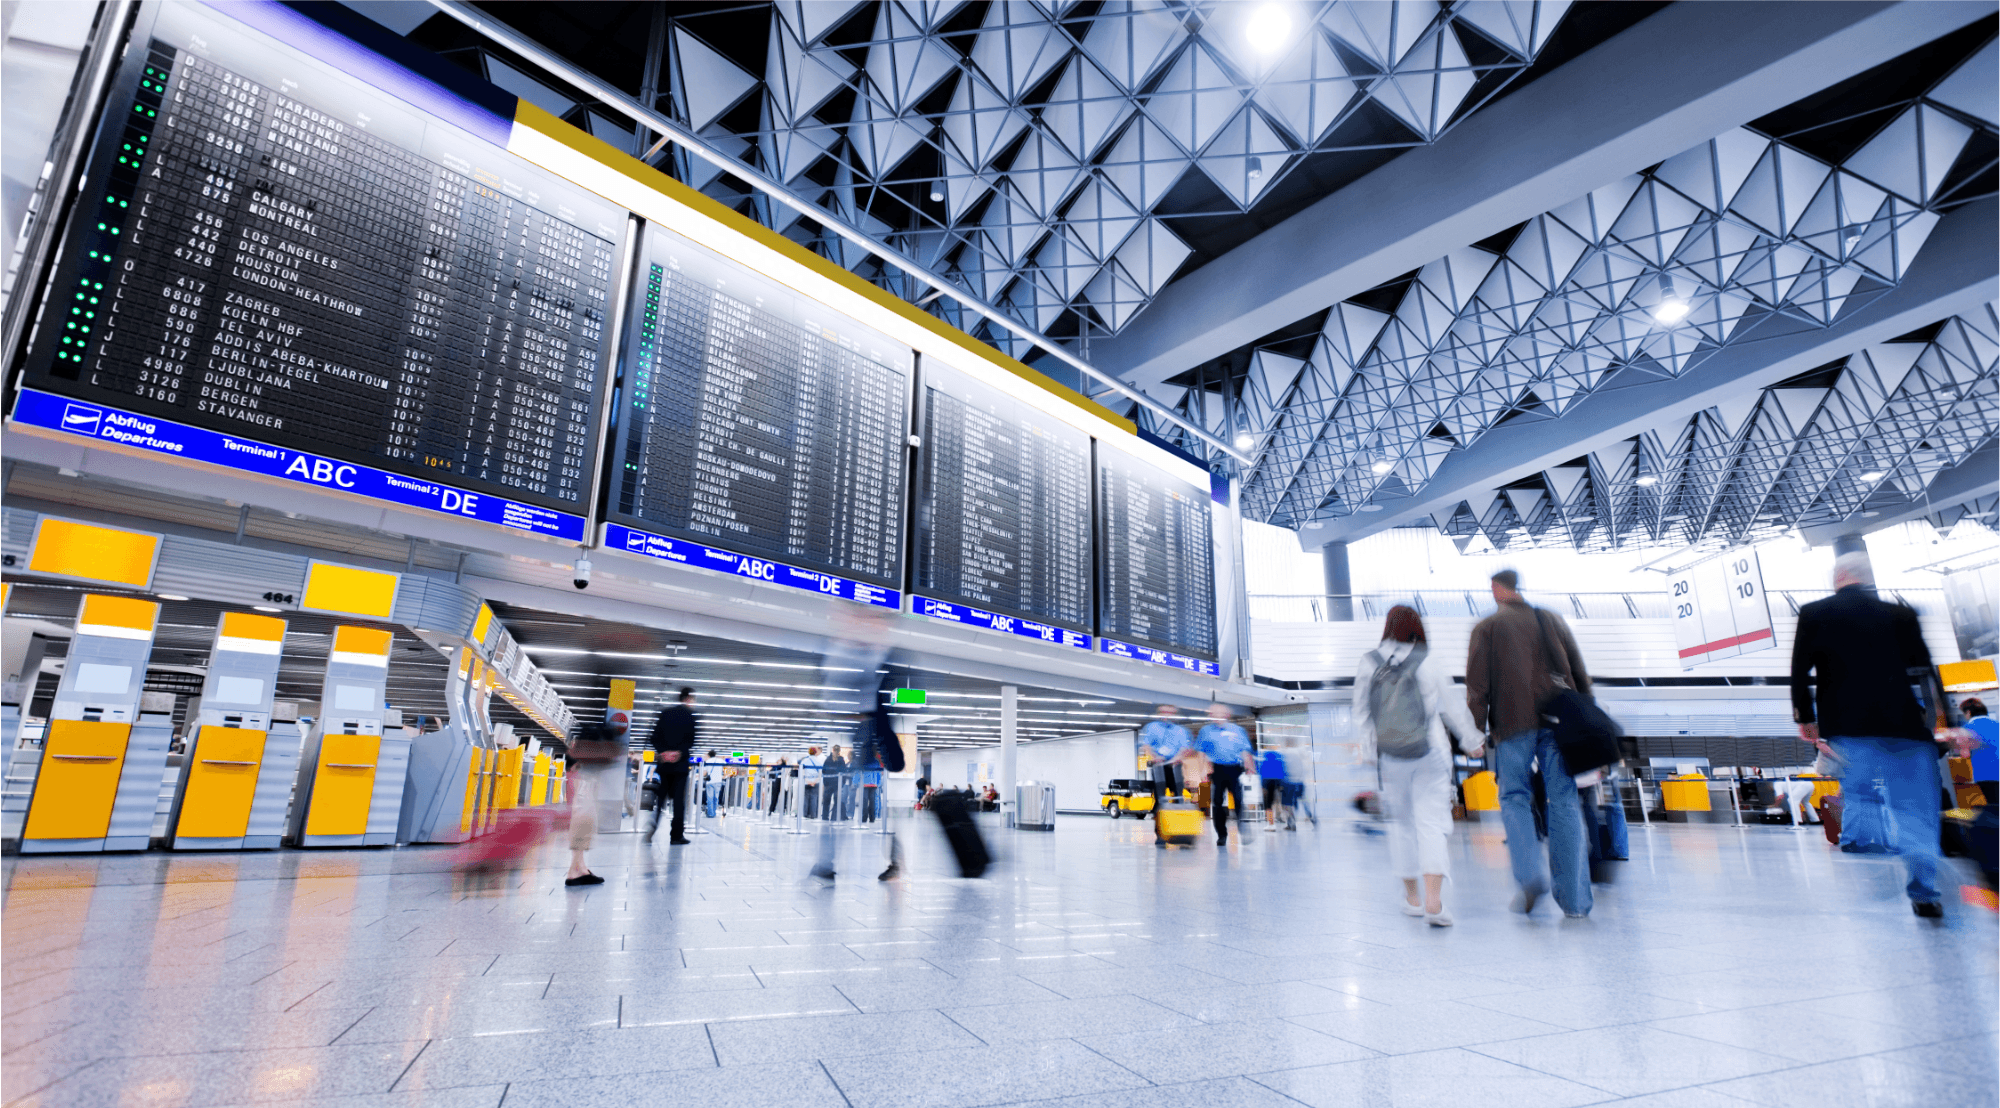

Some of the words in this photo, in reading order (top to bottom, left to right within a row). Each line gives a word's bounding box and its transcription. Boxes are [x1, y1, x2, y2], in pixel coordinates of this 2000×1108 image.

[220, 84, 255, 106] 3102
[274, 108, 339, 142] HELSINKI
[224, 72, 259, 95] 2188
[277, 96, 343, 132] VARADERO
[223, 112, 249, 130] 462
[268, 131, 309, 155] MIAMI
[226, 100, 252, 118] 468
[271, 119, 338, 154] PORTLAND
[206, 132, 242, 154] 3236
[206, 173, 233, 191] 494
[252, 191, 313, 221] CALGARY
[202, 185, 229, 203] 875
[249, 203, 317, 236] MONTREAL
[191, 224, 219, 241] 442
[239, 240, 300, 269] DETROIT
[195, 211, 222, 228] 456
[242, 228, 269, 244] LOS
[278, 241, 337, 269] ANGELES
[188, 237, 215, 254] 440
[235, 253, 298, 282] HOUSTON
[123, 259, 134, 271] O
[176, 276, 205, 292] 417
[225, 292, 280, 316] ZAGREB
[174, 246, 212, 267] 4726
[233, 266, 362, 316] LONDON-HEATHROW
[116, 287, 125, 298] L
[169, 303, 197, 319] 686
[219, 318, 245, 334] TEL
[256, 329, 291, 347] AVIV
[120, 274, 128, 284] L
[162, 286, 201, 306] 6808
[222, 305, 268, 326] KOELN
[278, 322, 302, 337] HBF
[112, 301, 120, 312] L
[165, 317, 194, 333] 590
[215, 331, 261, 352] ADDIS
[271, 347, 388, 389] ABEBA-KHARTOUM
[709, 346, 736, 363] BILBAO
[708, 356, 756, 380] DUESSELDORF
[95, 359, 103, 369] L
[139, 370, 179, 389] 3126
[201, 385, 258, 408] BERGEN
[107, 316, 116, 326] L
[163, 331, 190, 347] 176
[211, 344, 319, 383] BERLIN-TEGEL
[565, 444, 582, 456] A13
[705, 384, 719, 394] NEW
[724, 391, 741, 402] YORK
[706, 374, 742, 393] BUDAPEST
[103, 330, 113, 341] J
[159, 345, 186, 360] 117
[208, 358, 291, 389] LJUBLJANA
[563, 456, 580, 467] B11
[704, 394, 736, 410] KOLKATA
[99, 344, 108, 355] L
[143, 356, 183, 375] 4980
[204, 372, 261, 395] DUBLIN
[562, 467, 579, 478] B32
[701, 412, 734, 429] CHICAGO
[703, 403, 731, 418] DALLAS
[736, 414, 752, 426] FORT
[105, 413, 156, 434] Abflug
[700, 422, 733, 438] DETROIT
[91, 374, 100, 384] L
[136, 384, 176, 403] 3160
[197, 399, 282, 429] STAVANGER
[559, 489, 576, 501] B13
[101, 426, 184, 452] Departures
[699, 432, 723, 445] PARIS
[746, 447, 754, 455] DE
[759, 451, 784, 465] GAULLE
[223, 438, 277, 459] Terminal
[280, 451, 286, 461] 1
[285, 455, 357, 487] ABC
[695, 471, 729, 487] VILNIUS
[695, 481, 728, 497] TORONTO
[386, 476, 430, 495] Terminal
[432, 487, 439, 496] 2
[441, 490, 479, 515] DE
[693, 491, 730, 507] HELSINKI
[691, 511, 748, 532] POZNAN/POSEN
[692, 502, 735, 519] AMSTERDAM
[690, 522, 719, 535] DUBLIN
[646, 545, 686, 561] Departures
[647, 535, 673, 549] Abflug
[704, 548, 732, 562] Terminal
[737, 558, 775, 580] ABC
[1731, 558, 1749, 576] 10
[789, 568, 813, 581] Terminal
[820, 575, 841, 595] DE
[1673, 580, 1689, 597] 20
[1736, 582, 1754, 599] 10
[263, 592, 293, 604] 464
[1677, 602, 1693, 619] 20
[990, 615, 1014, 632] ABC
[1041, 627, 1054, 641] DE
[1151, 650, 1167, 664] ABC
[1185, 658, 1194, 669] DE
